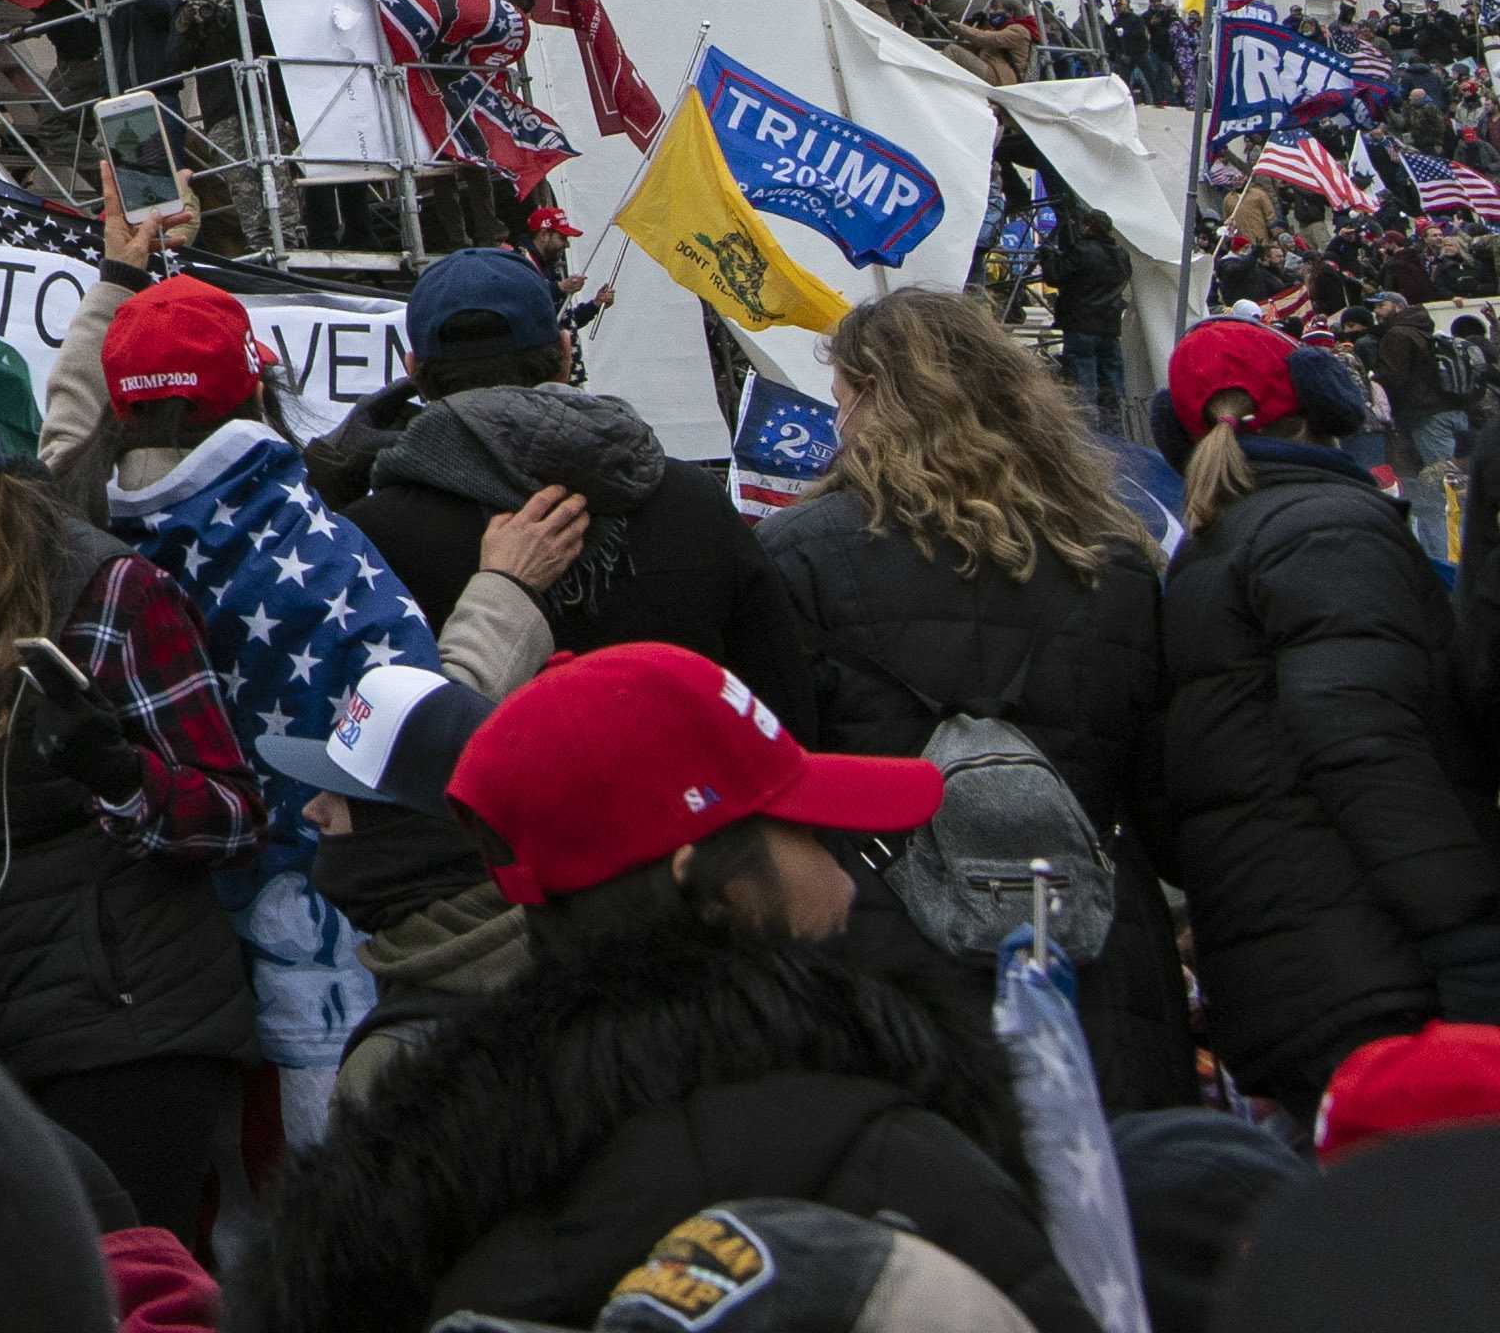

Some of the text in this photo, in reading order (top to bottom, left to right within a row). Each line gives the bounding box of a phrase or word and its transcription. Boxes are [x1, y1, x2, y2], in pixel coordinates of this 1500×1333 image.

[727, 85, 921, 216] TRUMP
[675, 240, 710, 271] DONT
[119, 372, 198, 393] TRUMP2020
[271, 322, 412, 403] VEN
